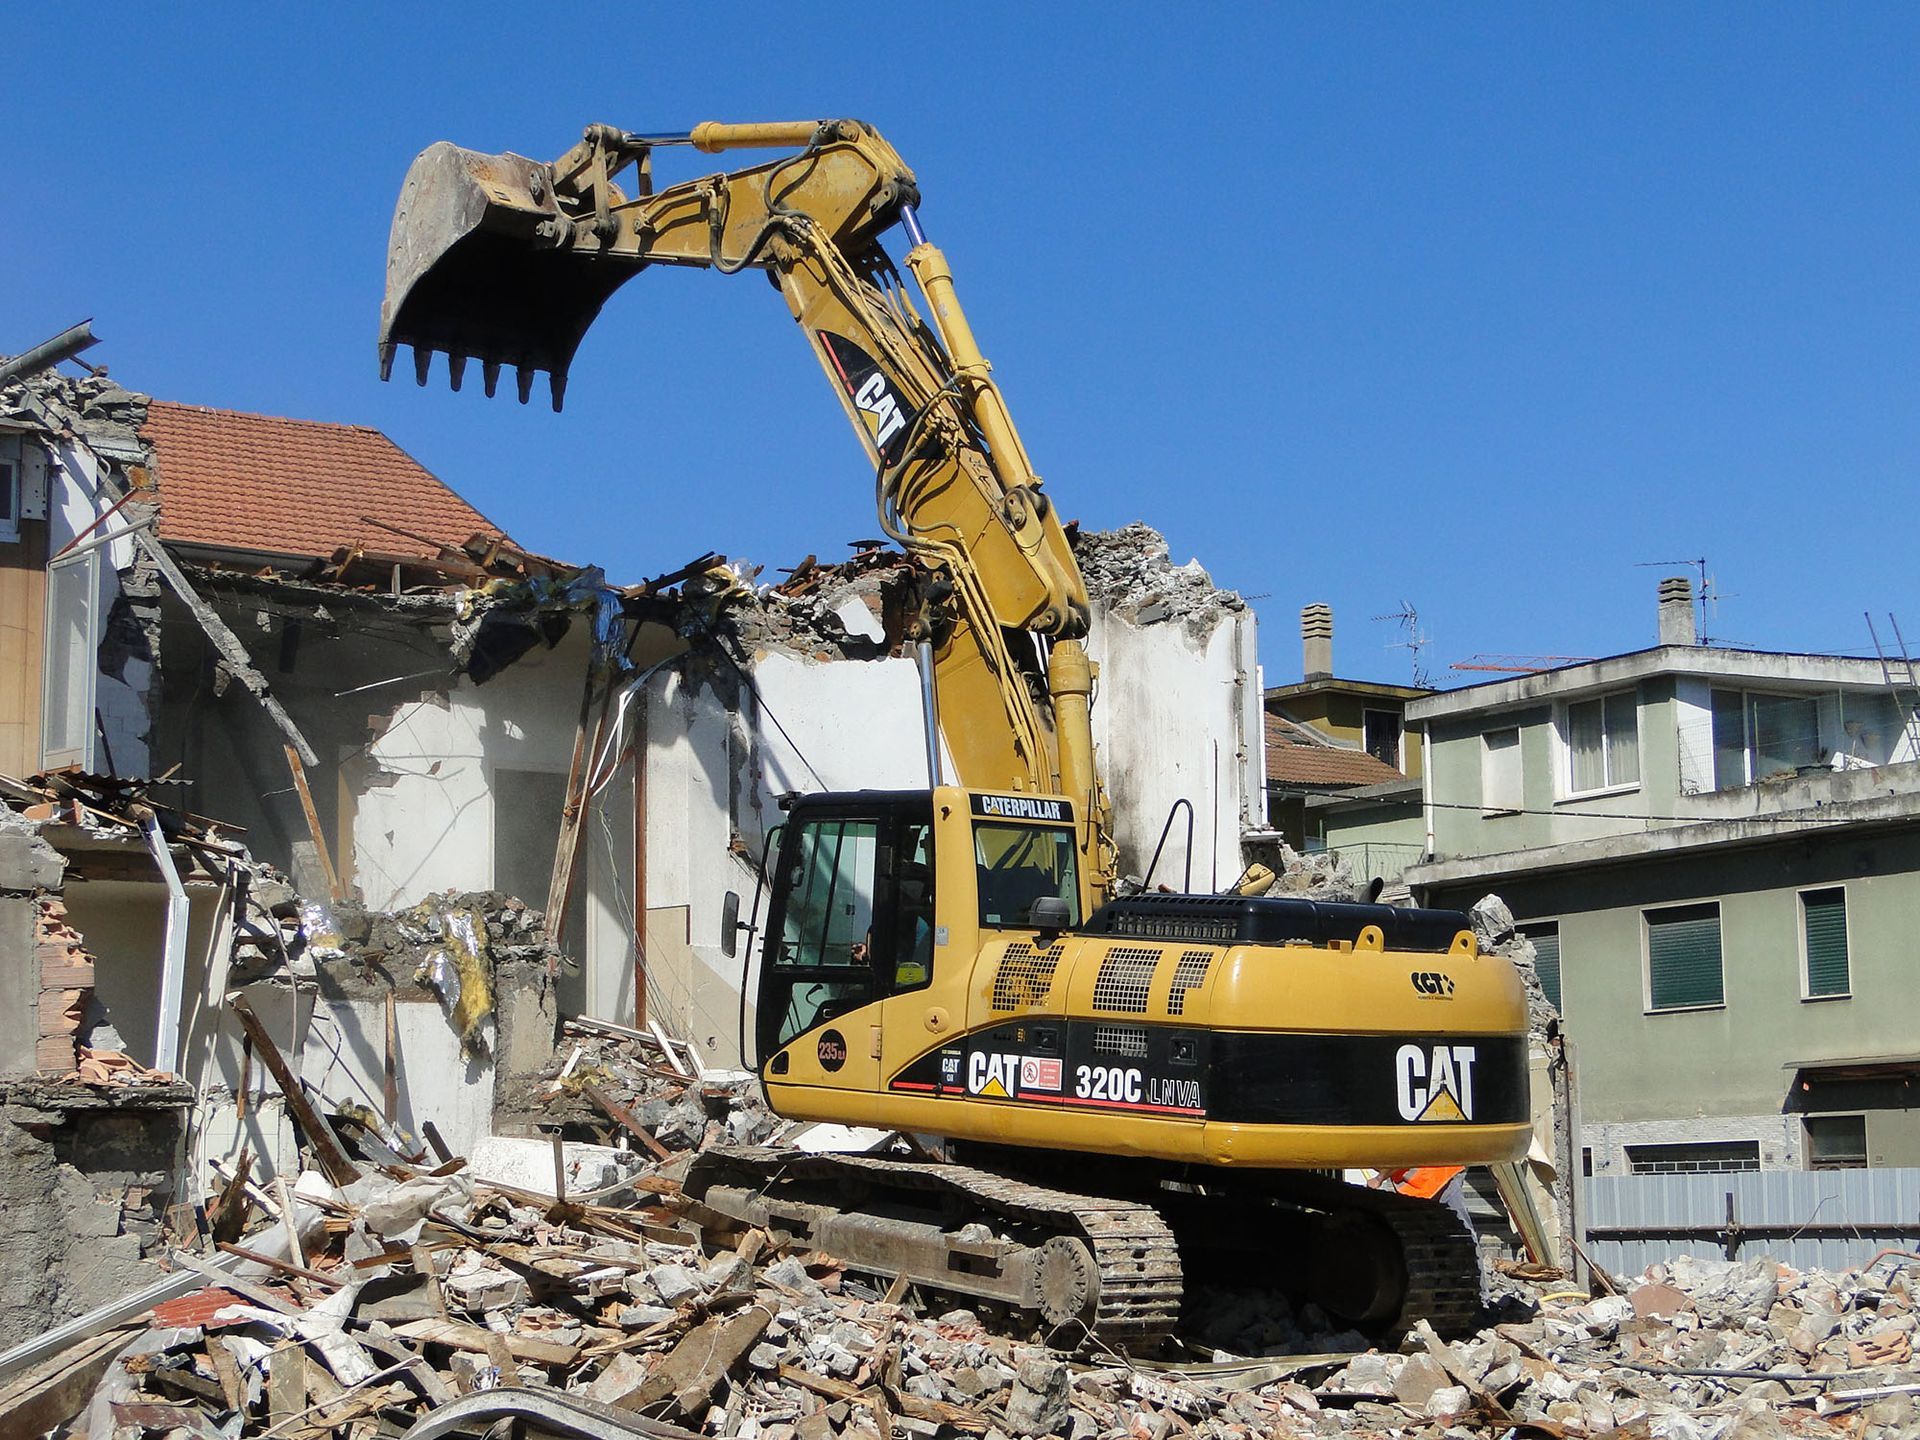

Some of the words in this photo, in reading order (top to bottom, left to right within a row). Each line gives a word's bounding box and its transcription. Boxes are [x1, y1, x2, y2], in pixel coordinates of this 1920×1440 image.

[855, 372, 906, 448] CAT
[982, 795, 1061, 820] CATERPILLAR
[942, 1058, 961, 1073] CAT
[968, 1051, 1019, 1098] CAT
[1075, 1065, 1142, 1103] 320C
[1150, 1078, 1201, 1108] LNVA
[1396, 1044, 1476, 1121] CAT
